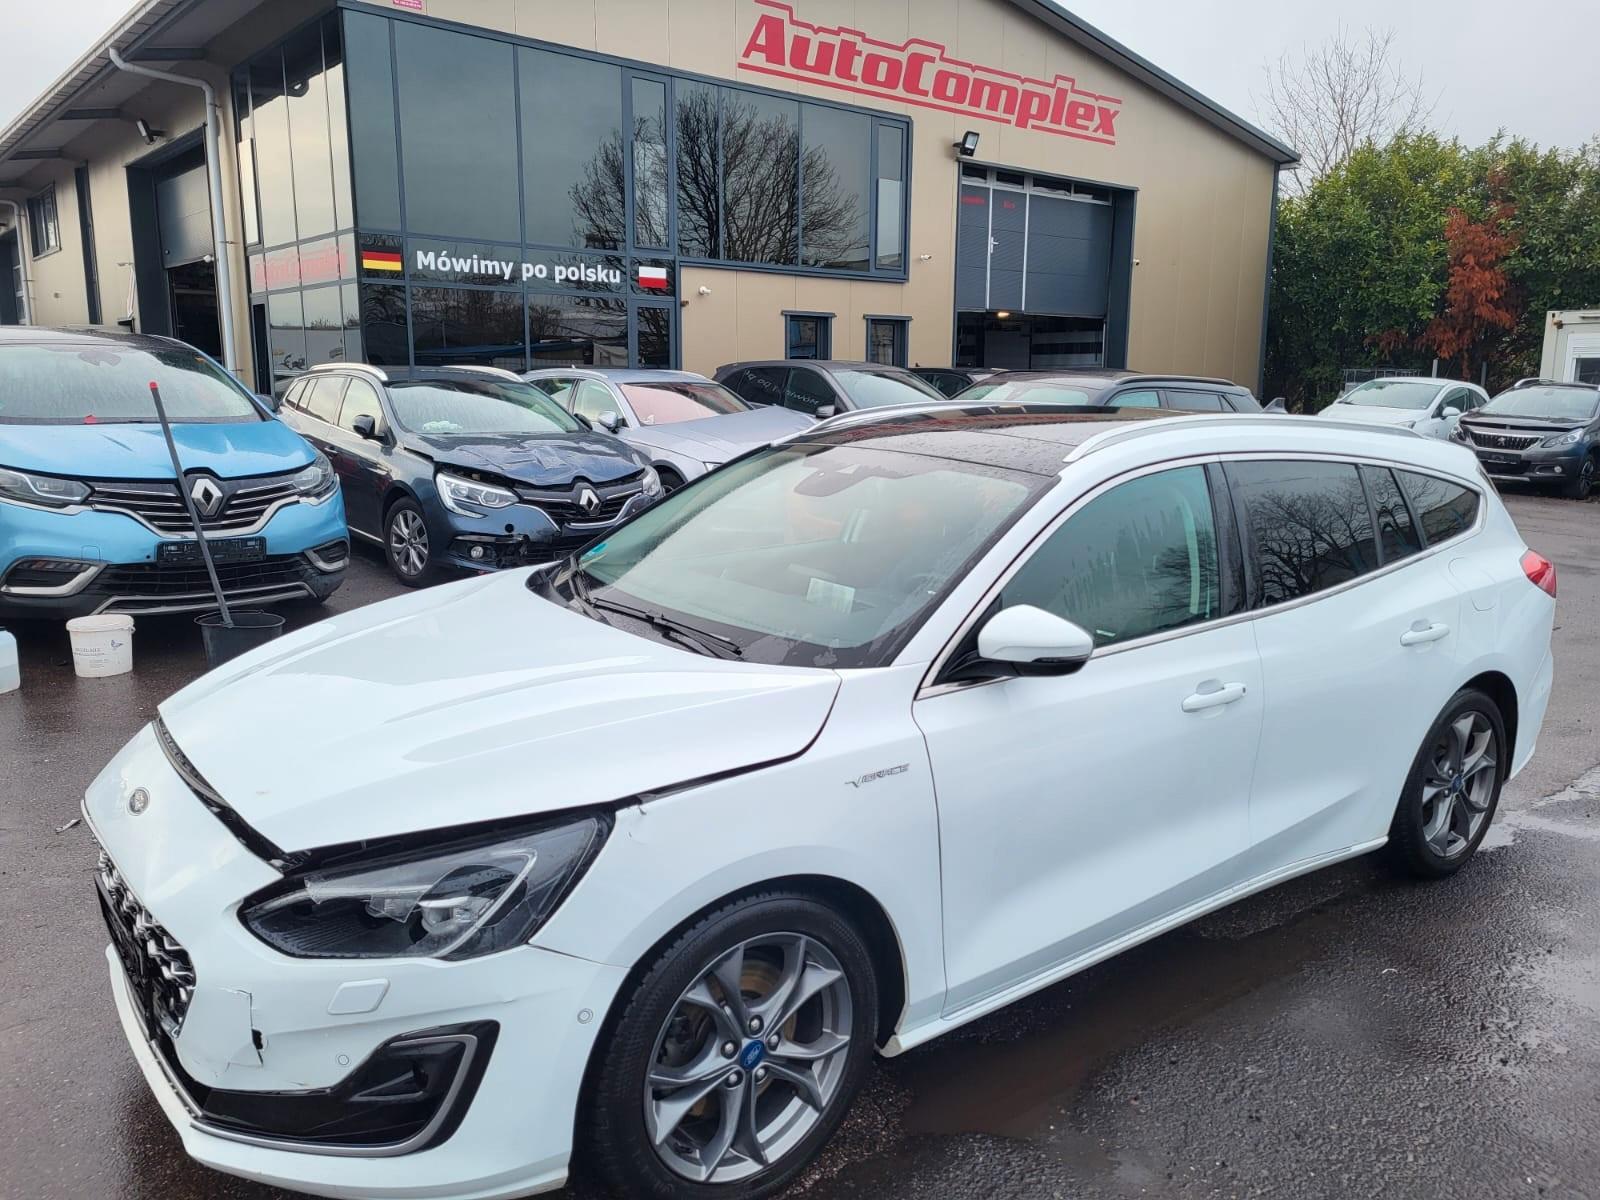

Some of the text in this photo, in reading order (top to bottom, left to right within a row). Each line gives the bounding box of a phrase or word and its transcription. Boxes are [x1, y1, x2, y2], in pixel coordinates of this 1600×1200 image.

[742, 14, 1120, 137] AutoComplex
[416, 250, 621, 283] Mówimy po polsku
